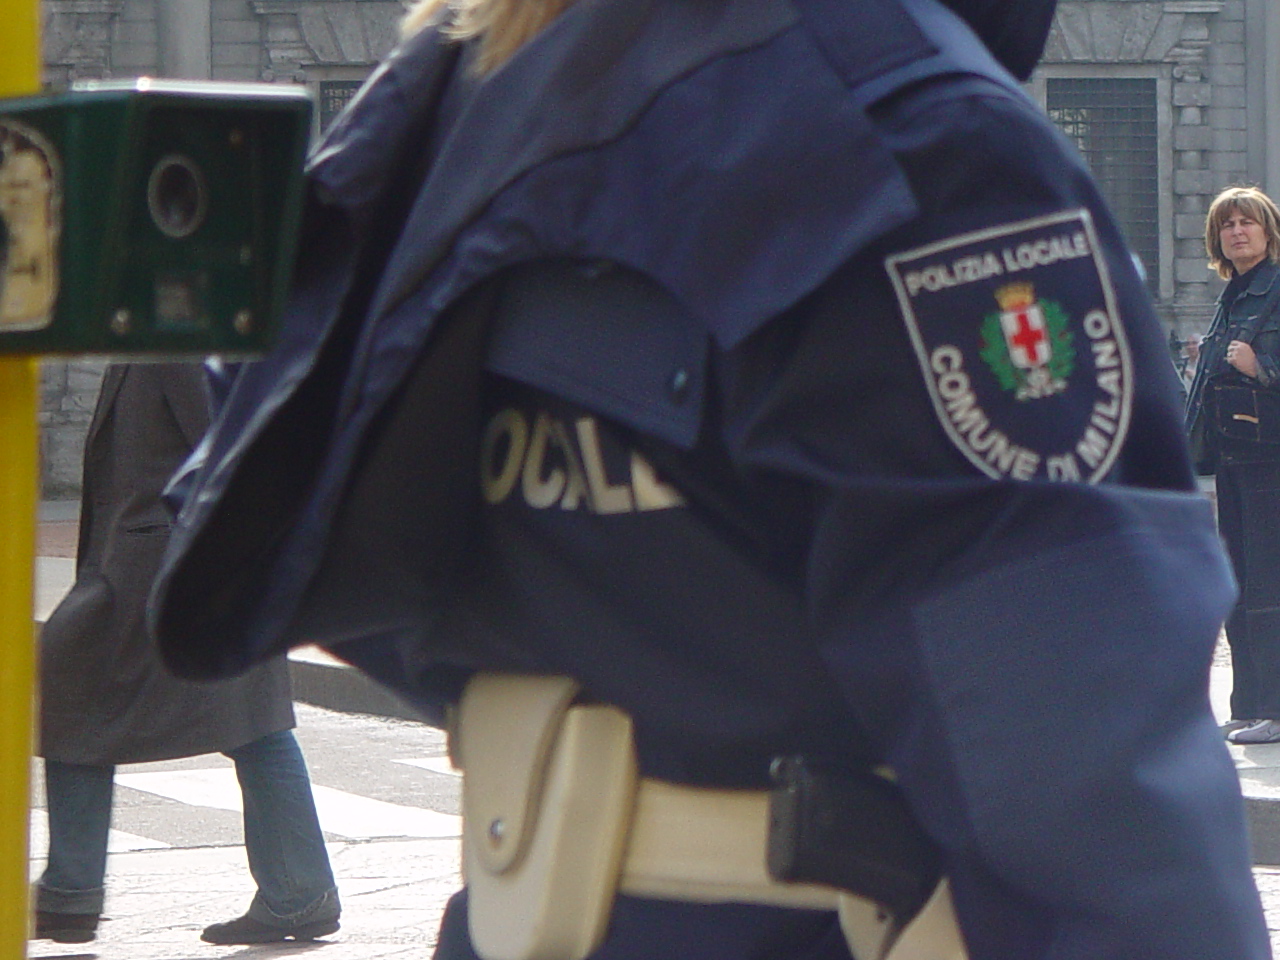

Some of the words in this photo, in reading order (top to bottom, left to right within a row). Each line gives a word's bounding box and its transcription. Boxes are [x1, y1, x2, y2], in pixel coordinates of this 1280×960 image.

[905, 250, 1003, 297] POLIZIA
[1002, 233, 1091, 273] LOCALE
[930, 344, 1041, 482] COMUNE
[1075, 309, 1123, 469] MILANO
